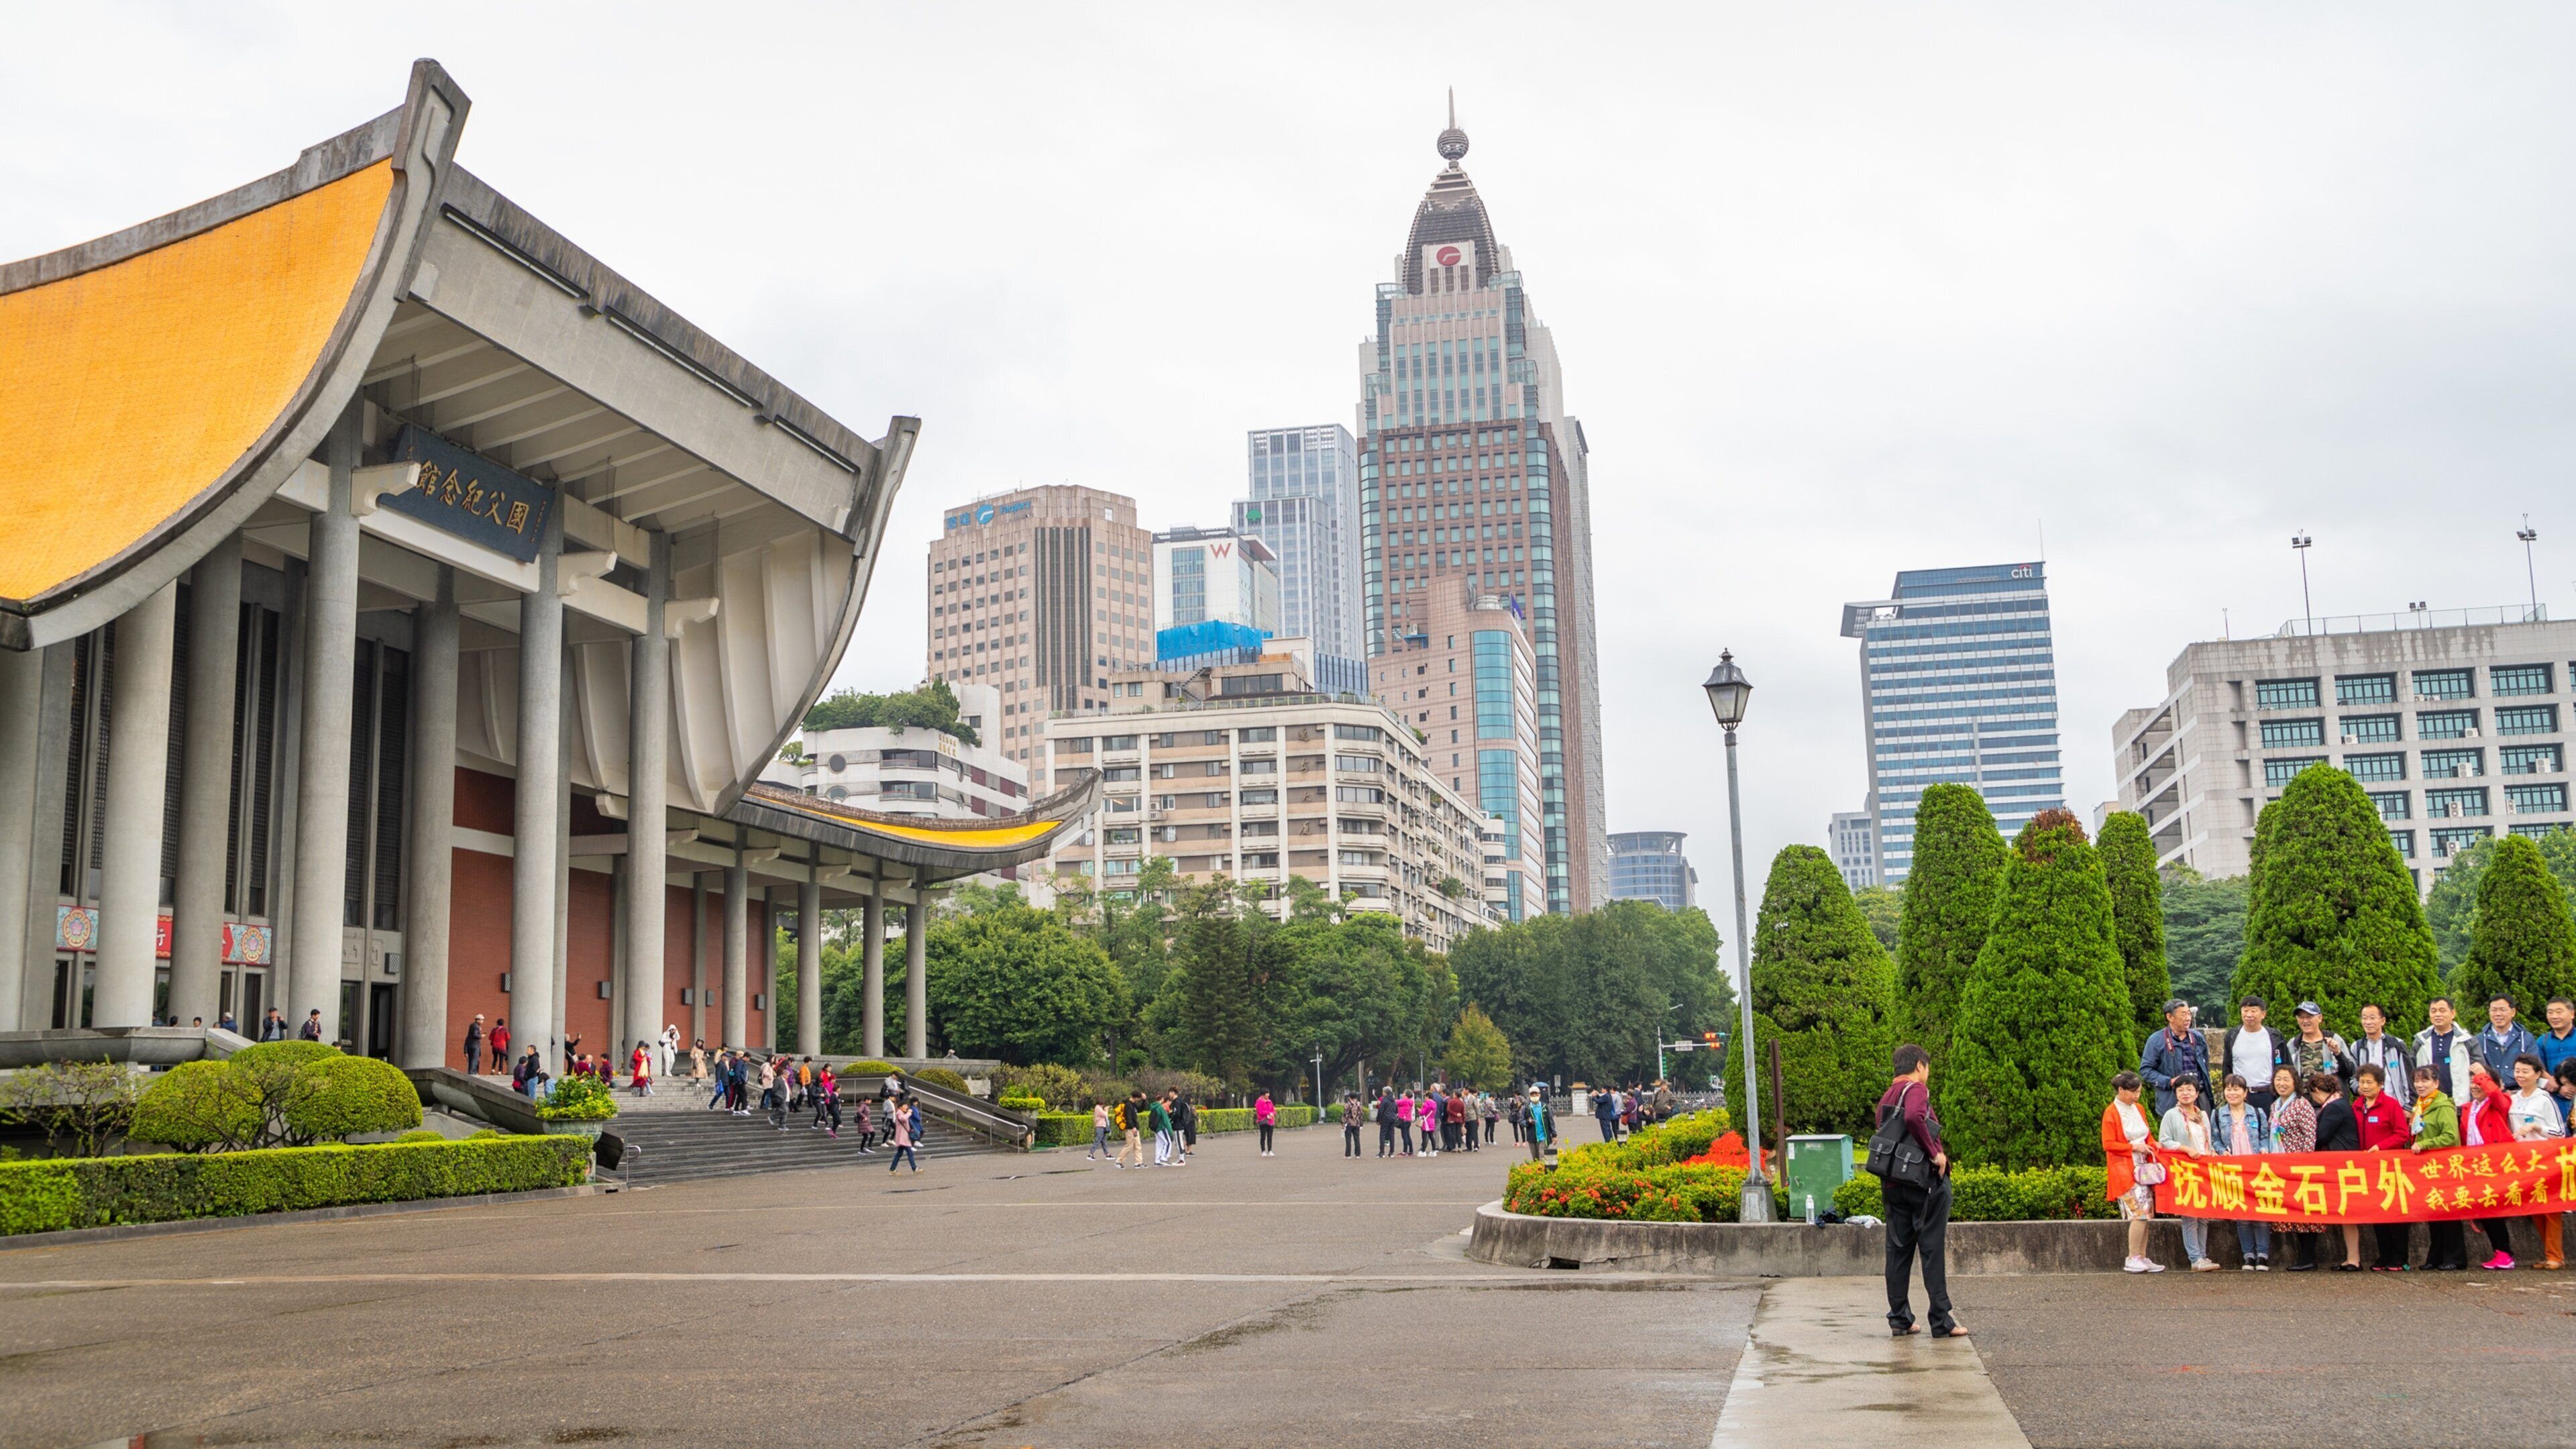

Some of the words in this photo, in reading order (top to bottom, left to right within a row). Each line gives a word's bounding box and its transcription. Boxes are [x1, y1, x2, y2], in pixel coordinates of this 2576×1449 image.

[416, 460, 530, 535] 國父紀念館
[1210, 542, 1232, 559] W
[2011, 565, 2033, 578] citi
[2418, 1148, 2548, 1181] 世界这么大
[2169, 1157, 2416, 1216] 抚顺金石户外
[2424, 1176, 2549, 1212] 我要去看看
